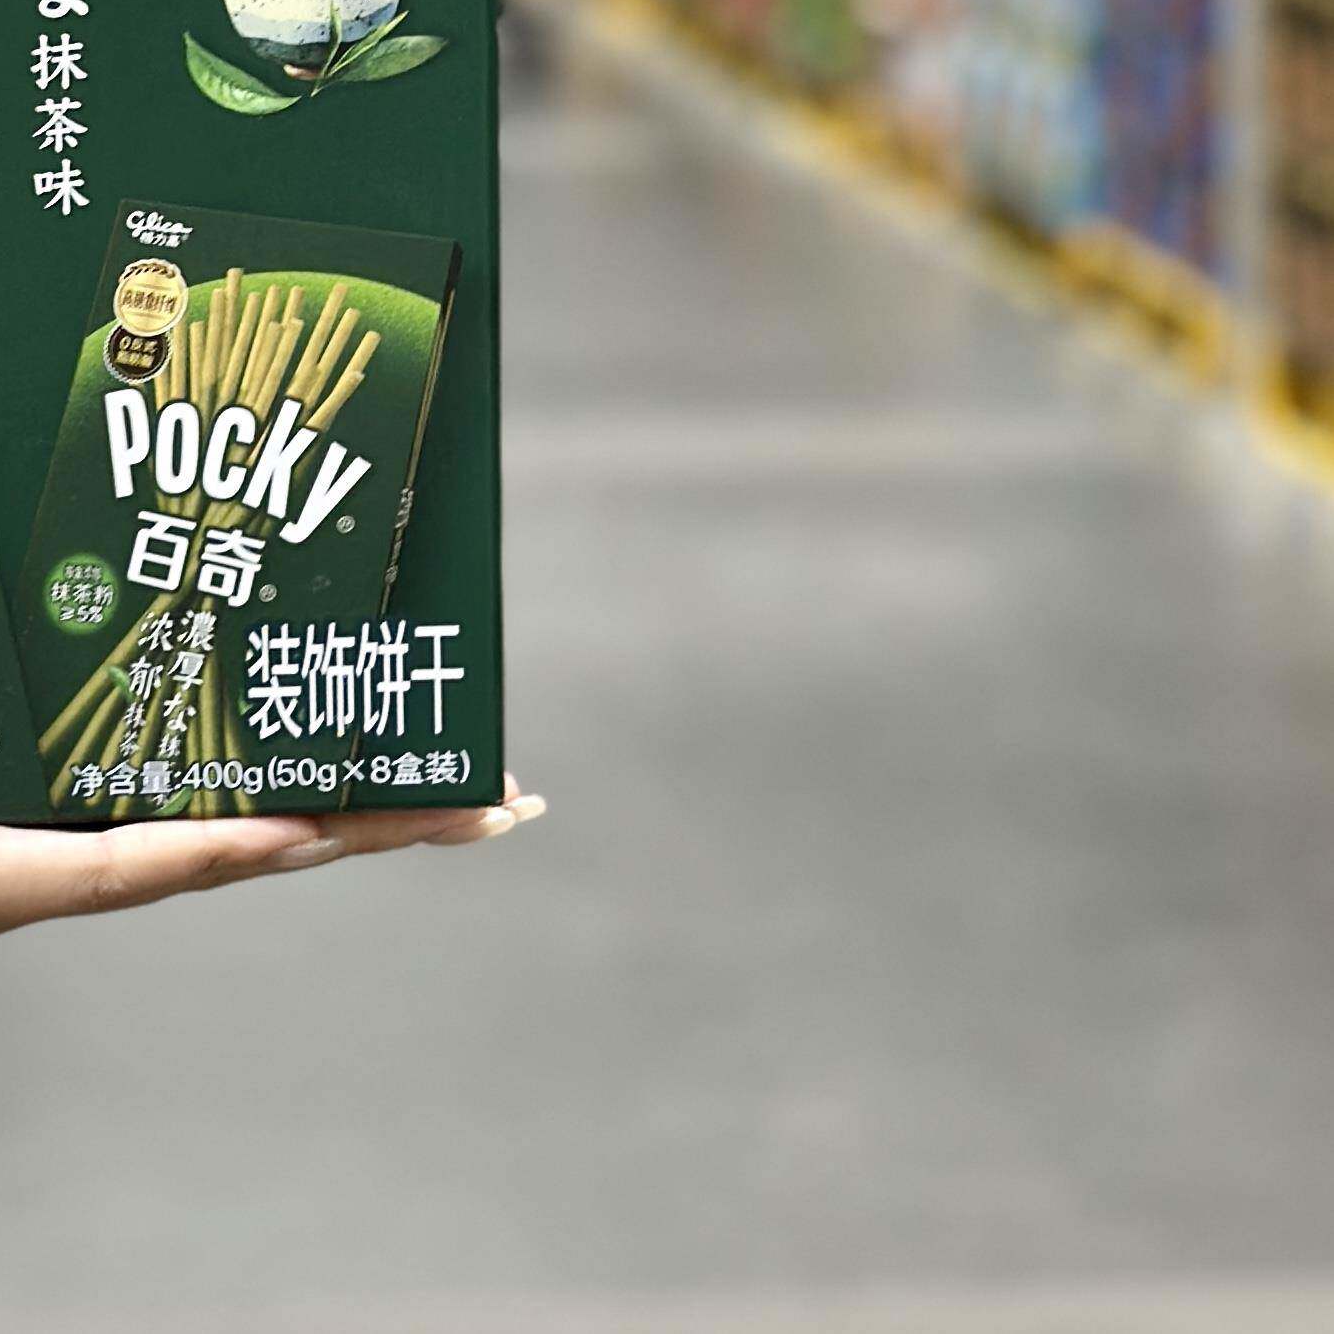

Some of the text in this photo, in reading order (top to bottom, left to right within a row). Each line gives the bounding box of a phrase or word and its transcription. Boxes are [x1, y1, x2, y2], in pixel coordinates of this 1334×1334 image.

[126, 210, 194, 238] Glico
[103, 387, 372, 545] Pocky
[126, 509, 267, 608] 百奇
[245, 619, 465, 741] 装饰饼干
